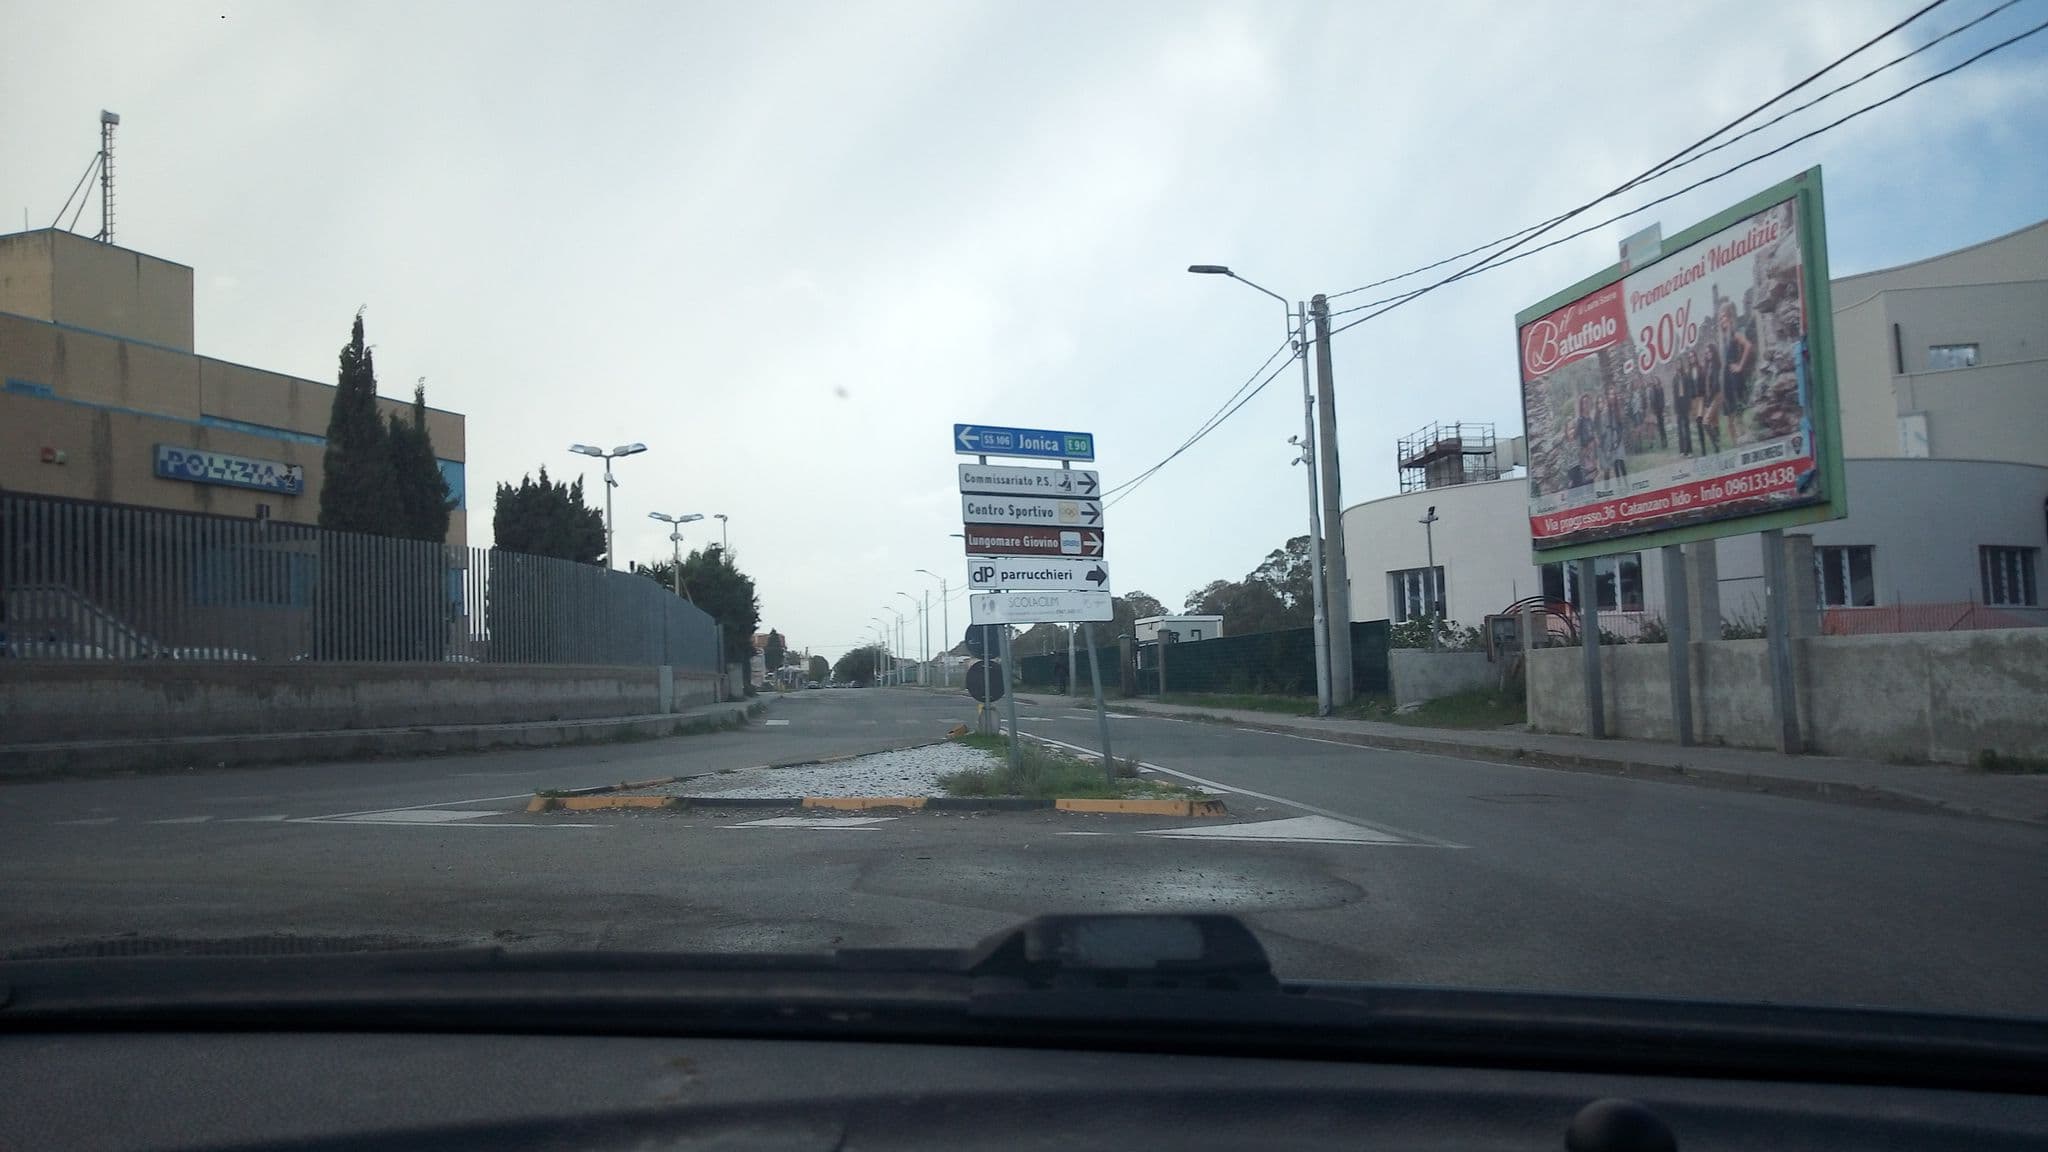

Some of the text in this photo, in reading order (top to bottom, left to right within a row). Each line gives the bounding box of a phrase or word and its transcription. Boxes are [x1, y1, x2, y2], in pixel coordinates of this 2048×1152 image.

[1630, 220, 1779, 314] Promozioni Natalizie
[1525, 316, 1616, 374] Batuffolo
[1019, 434, 1059, 452] Jonica
[167, 449, 278, 488] POLIZIA
[964, 473, 1053, 487] Commissariato P.S.
[1545, 515, 1559, 532] Via
[1620, 497, 1669, 517] Catanzaro
[1700, 484, 1723, 502] Info
[1725, 466, 1796, 496] 096133438
[967, 503, 1054, 519] Centro Sportivo
[968, 534, 1059, 549] Lungomare Giovino
[1001, 569, 1073, 582] parrucchieri
